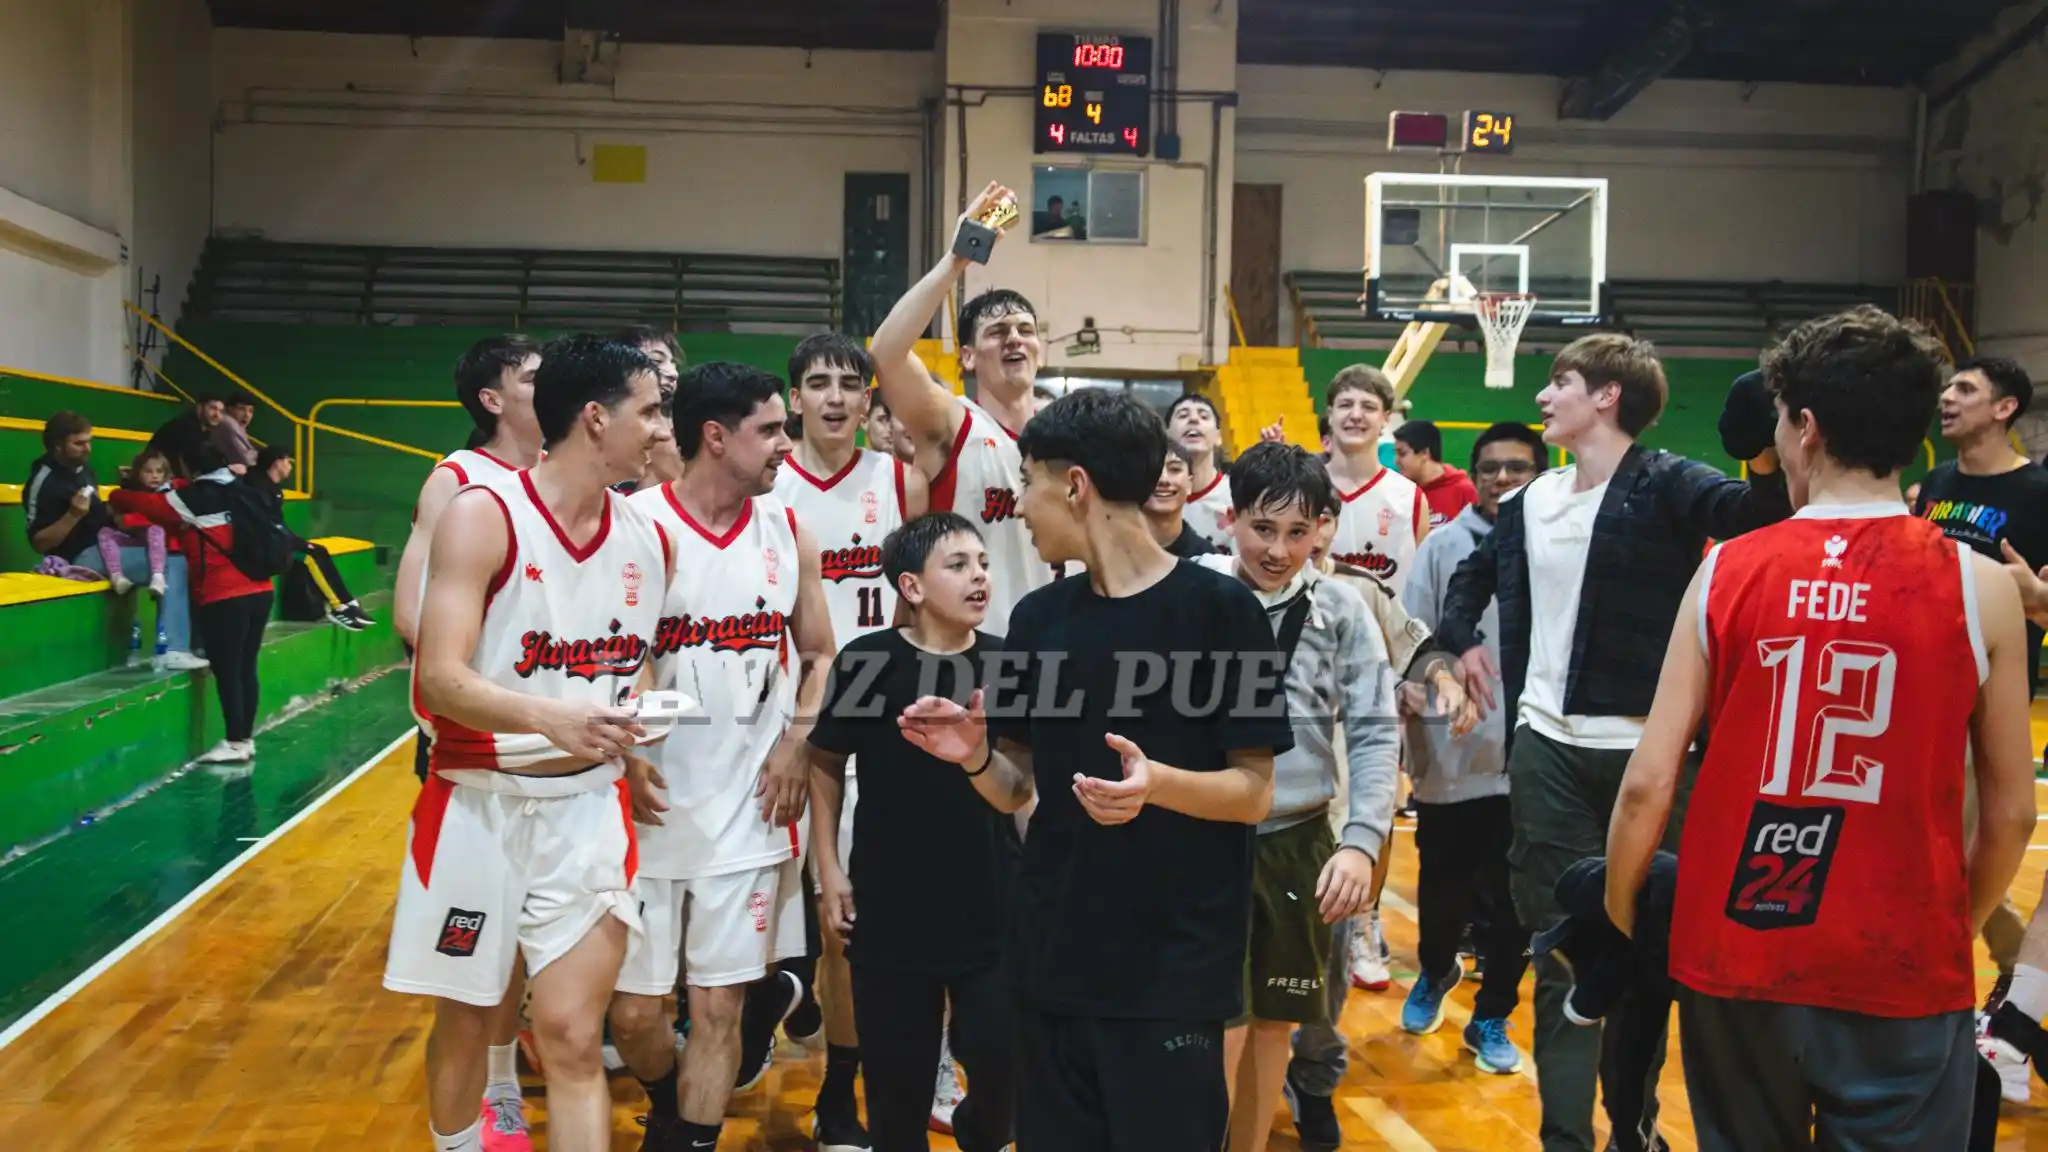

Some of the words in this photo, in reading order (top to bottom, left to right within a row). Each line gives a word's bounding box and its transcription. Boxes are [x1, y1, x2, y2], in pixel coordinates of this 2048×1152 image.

[1074, 43, 1124, 68] 10:00
[1043, 84, 1072, 108] 68
[1086, 103, 1102, 125] 4
[1050, 123, 1065, 144] 4
[1070, 131, 1116, 145] FALTAS
[1123, 126, 1138, 148] 4
[1472, 114, 1512, 147] 24
[1922, 500, 2008, 540] THRASHER
[857, 587, 884, 627] 11
[1787, 579, 1872, 622] FEDE
[1757, 635, 1897, 804] 12
[1753, 813, 1832, 856] red
[1735, 854, 1821, 914] 24
[448, 914, 483, 931] red
